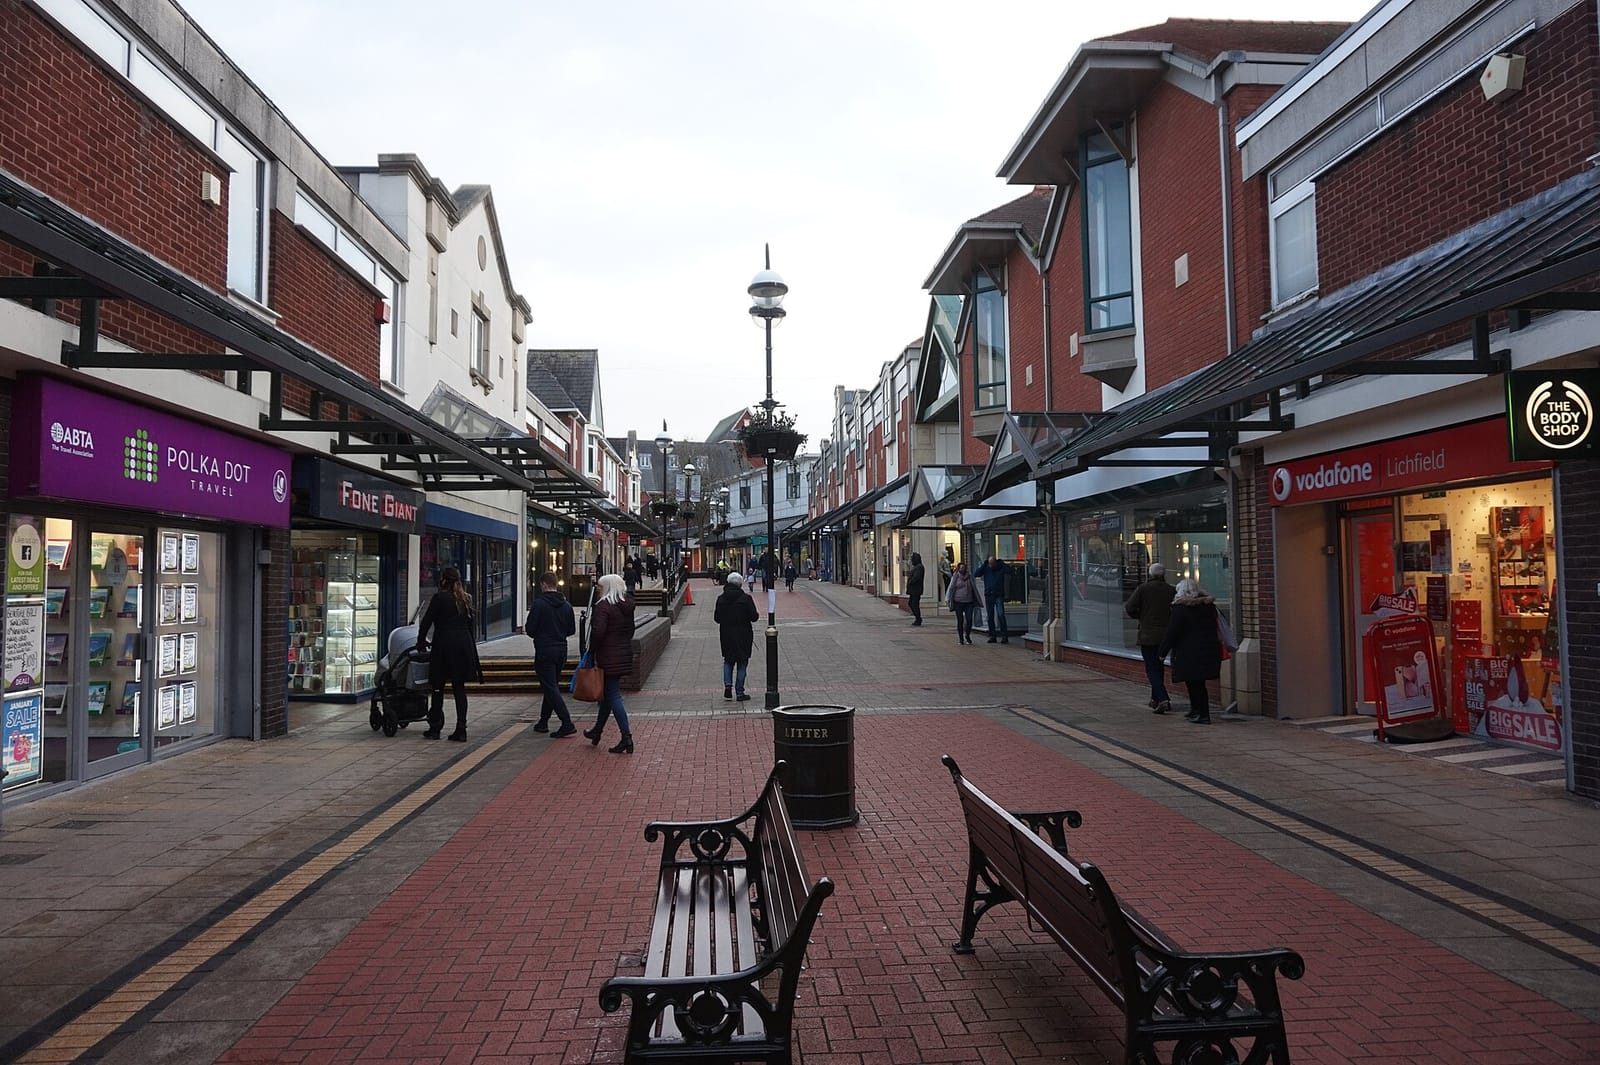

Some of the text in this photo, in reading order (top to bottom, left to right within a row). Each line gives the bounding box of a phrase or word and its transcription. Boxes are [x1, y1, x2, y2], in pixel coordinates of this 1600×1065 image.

[1547, 402, 1571, 412] THE
[1540, 412, 1580, 424] BODY
[1543, 424, 1579, 437] SHOP
[63, 427, 94, 449] ABTA
[167, 446, 251, 483] POLKA DOT
[1296, 449, 1445, 491] vodafone Lichfield
[190, 480, 233, 497] TRAVEL
[339, 480, 418, 522] FONE GIANT
[12, 583, 39, 591] AND OFFERS
[1379, 594, 1416, 612] BIG SALE
[1490, 660, 1508, 669] BIG
[15, 676, 30, 686] DEAL!
[1466, 681, 1484, 696] BIG
[10, 699, 33, 710] JANUARY
[1467, 700, 1484, 710] SALE
[5, 706, 38, 728] SALE
[785, 727, 829, 738] LITTER
[1489, 710, 1559, 744] BIG SALE
